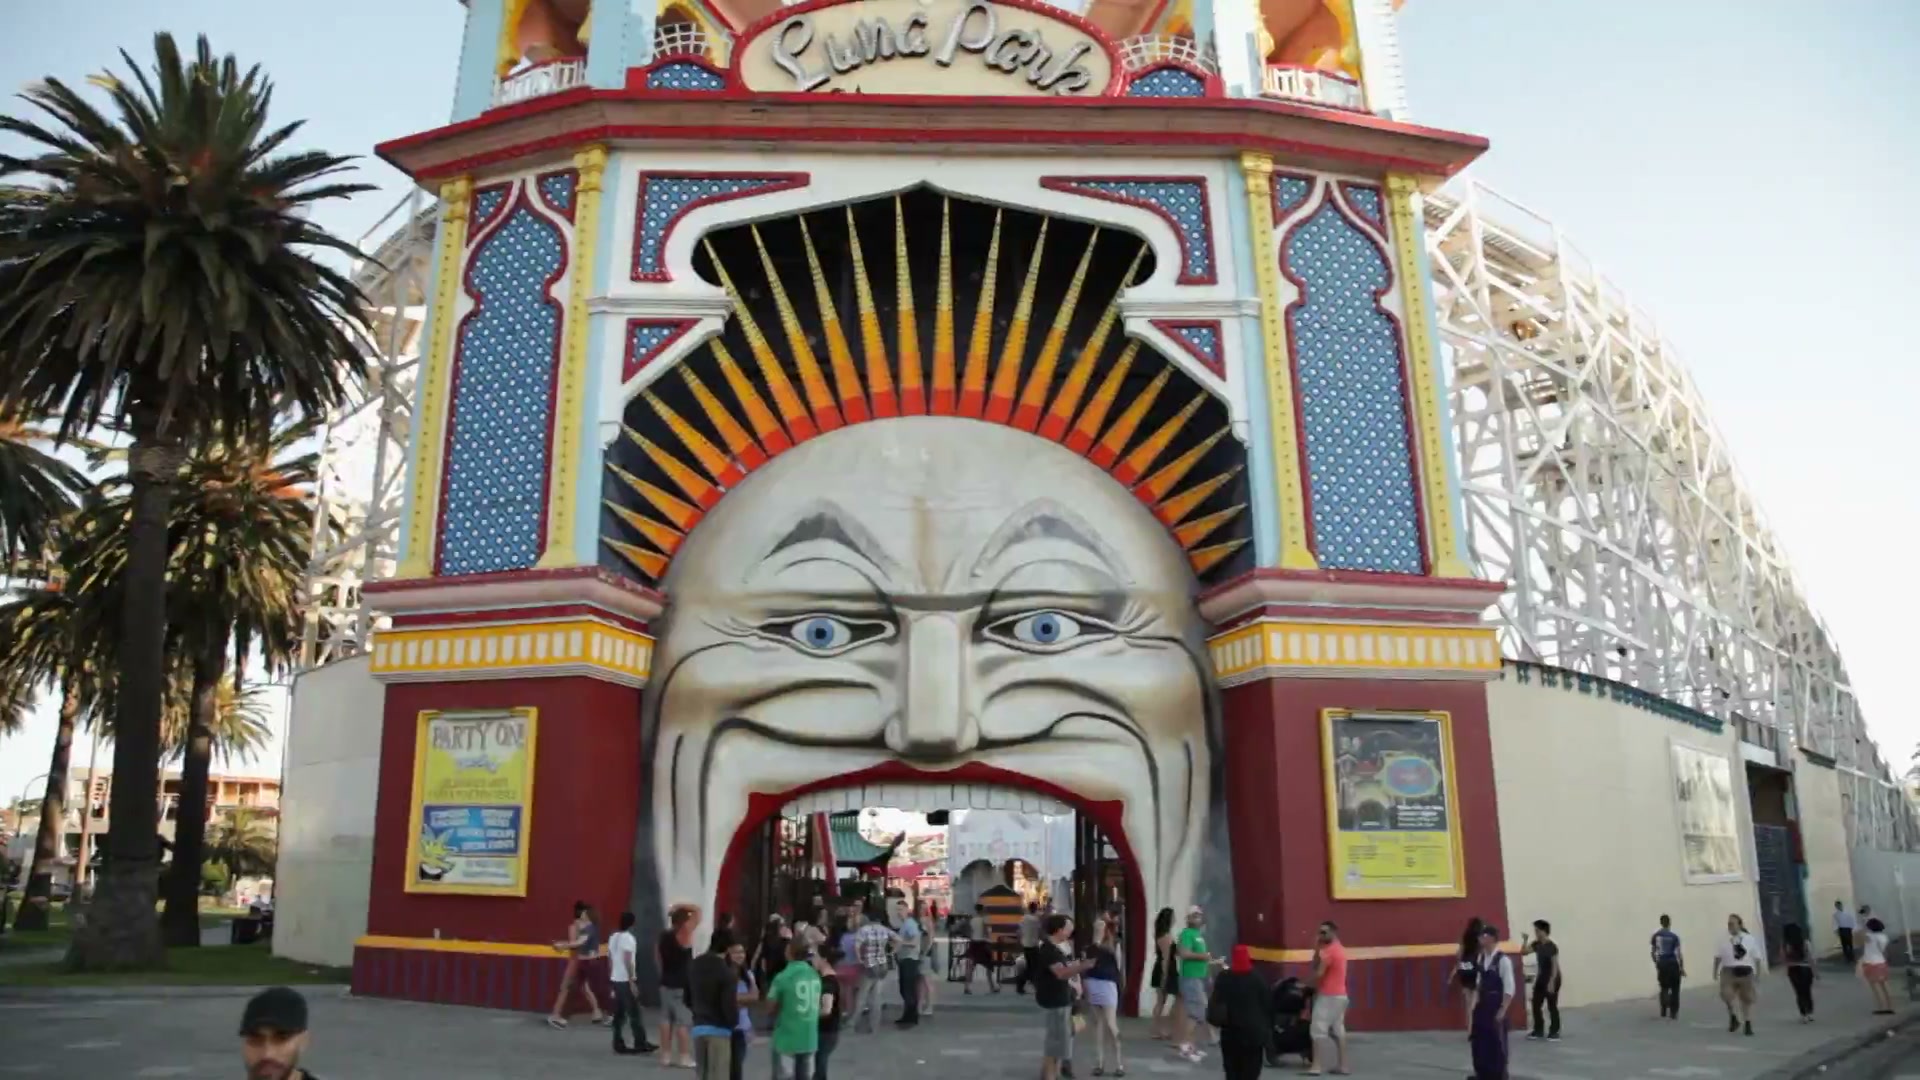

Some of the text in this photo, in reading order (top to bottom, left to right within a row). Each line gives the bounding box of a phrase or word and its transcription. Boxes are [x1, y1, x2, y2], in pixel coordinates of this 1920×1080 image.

[772, 4, 1093, 96] Luna Park
[432, 720, 494, 751] PARTY
